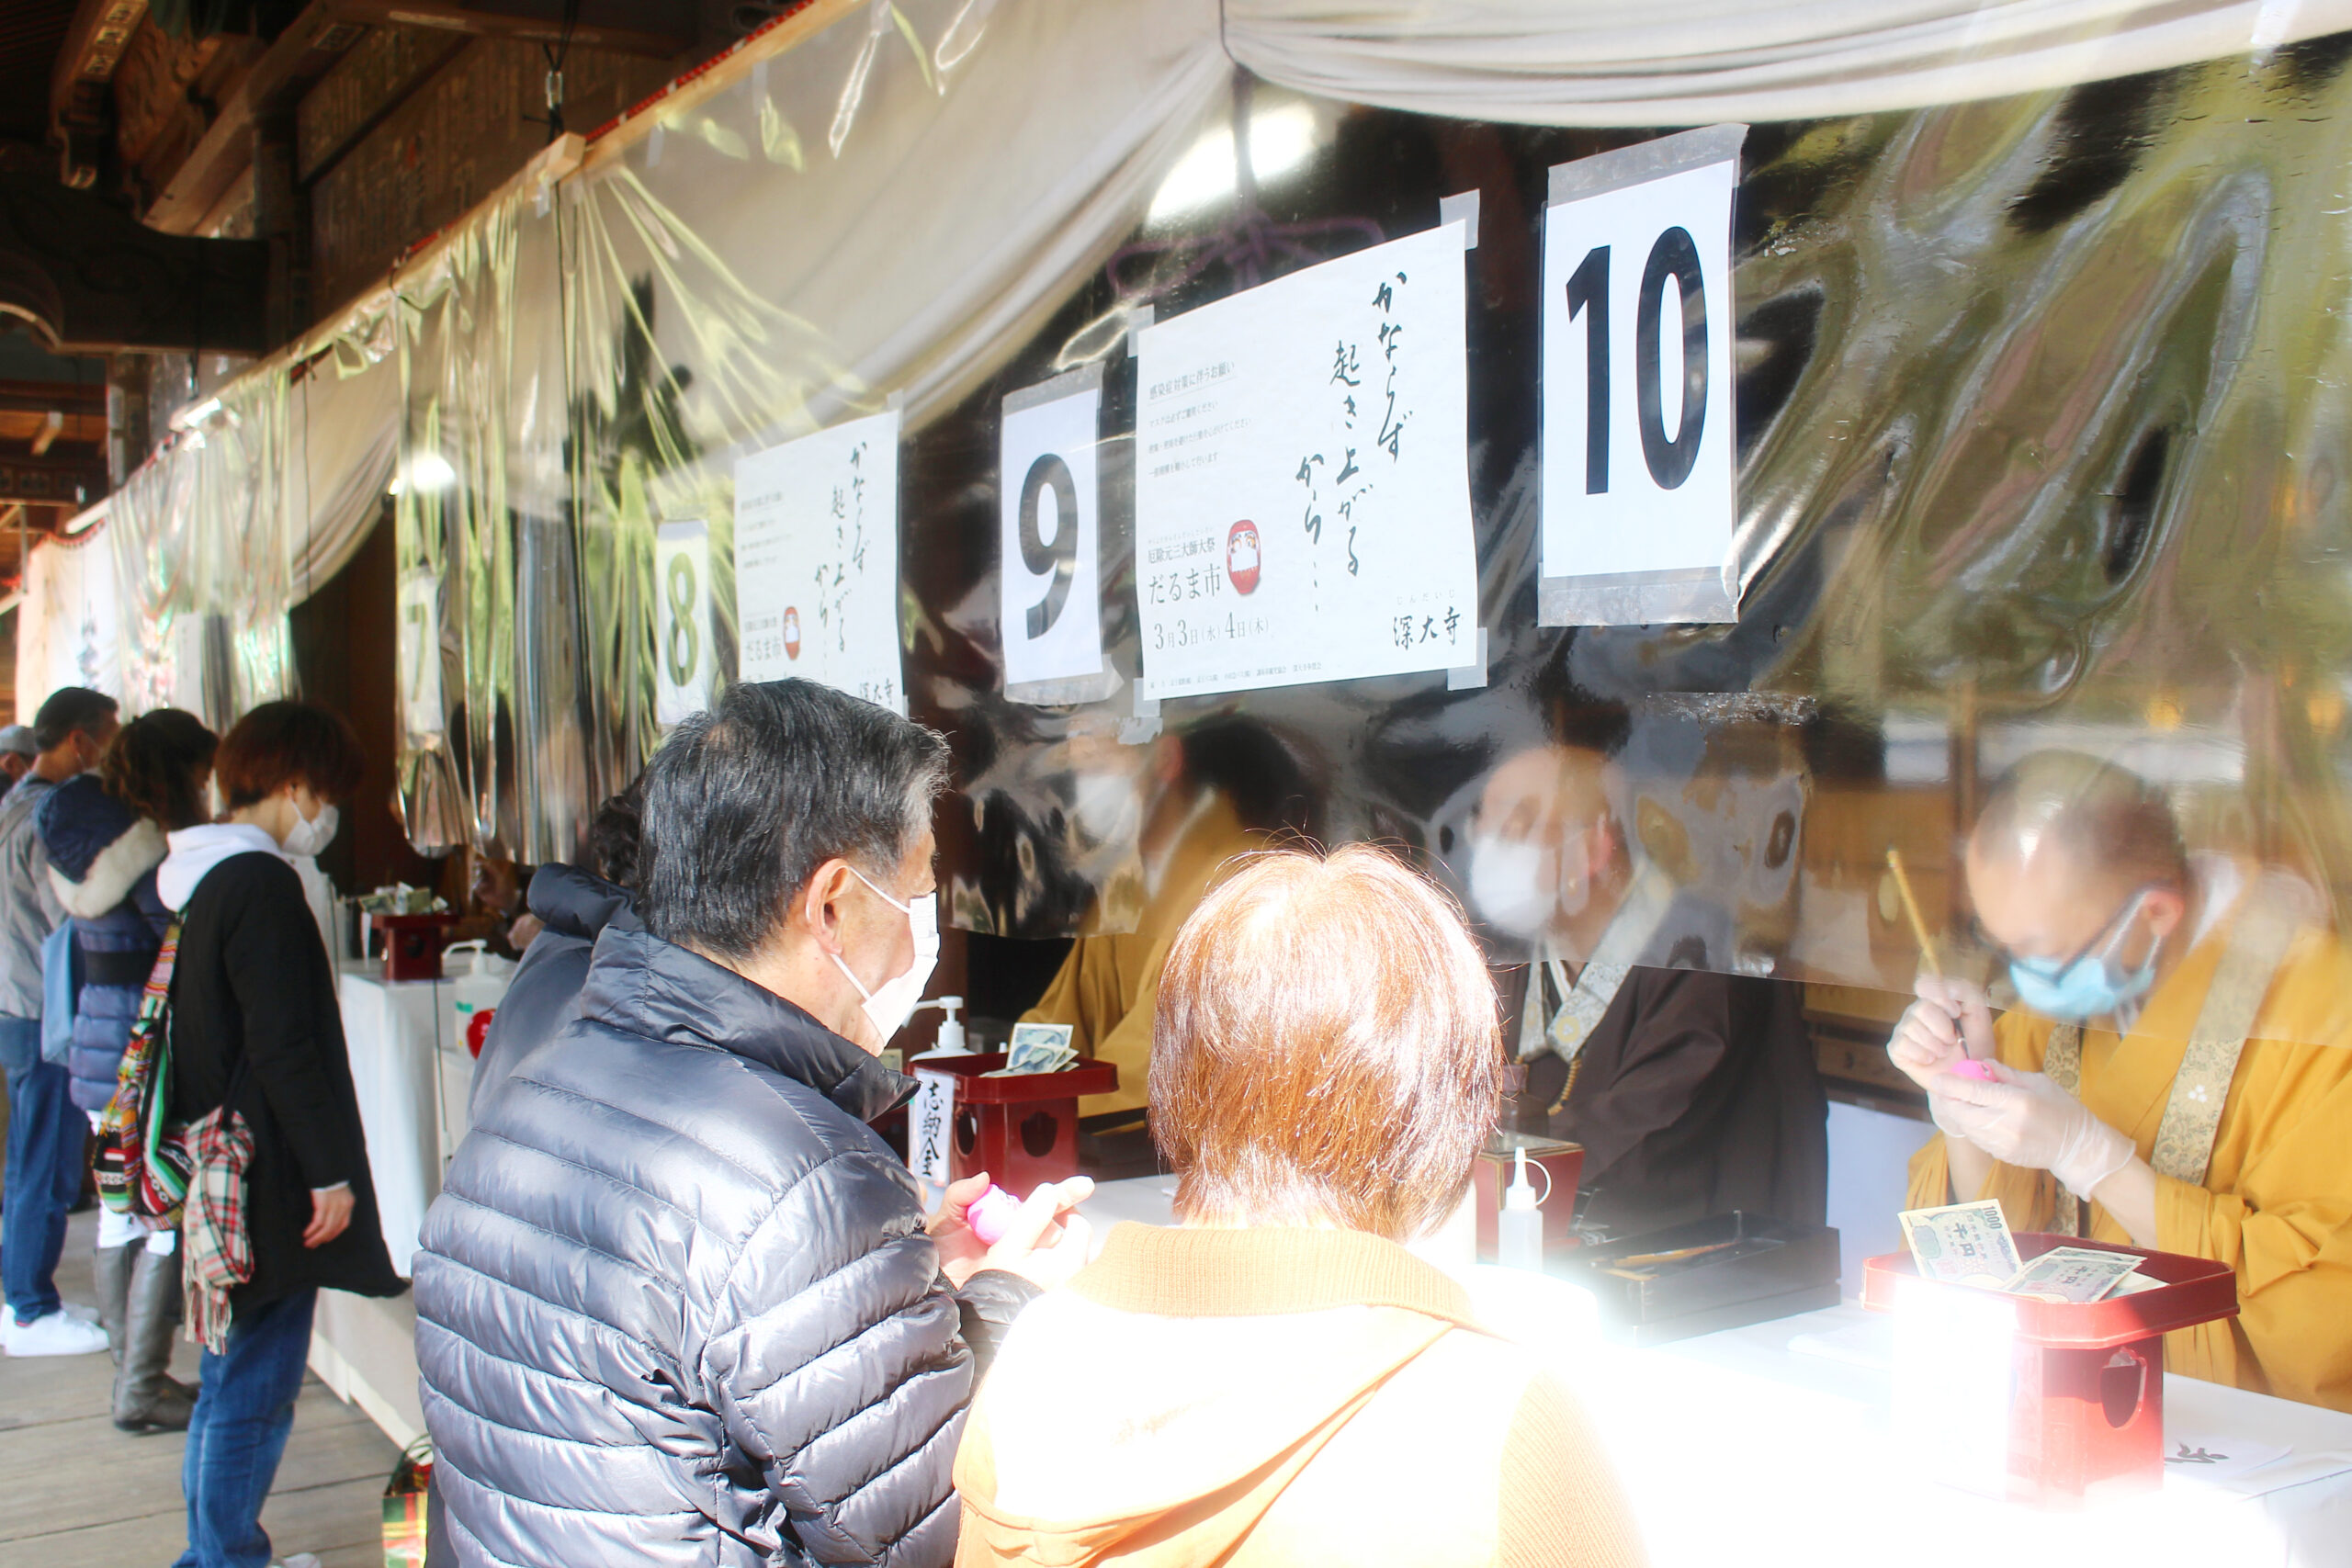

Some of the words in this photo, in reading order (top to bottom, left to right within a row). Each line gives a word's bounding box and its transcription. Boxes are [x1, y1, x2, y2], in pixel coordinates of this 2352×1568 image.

[1373, 272, 1413, 463] かならず
[1566, 226, 1708, 495] 10
[1330, 341, 1374, 577] 起き上がる
[666, 553, 698, 687] 8
[1018, 454, 1079, 640] 9
[1148, 563, 1221, 605] だるま市
[1393, 605, 1461, 650] 深大寺
[1983, 1205, 2002, 1229] 1000
